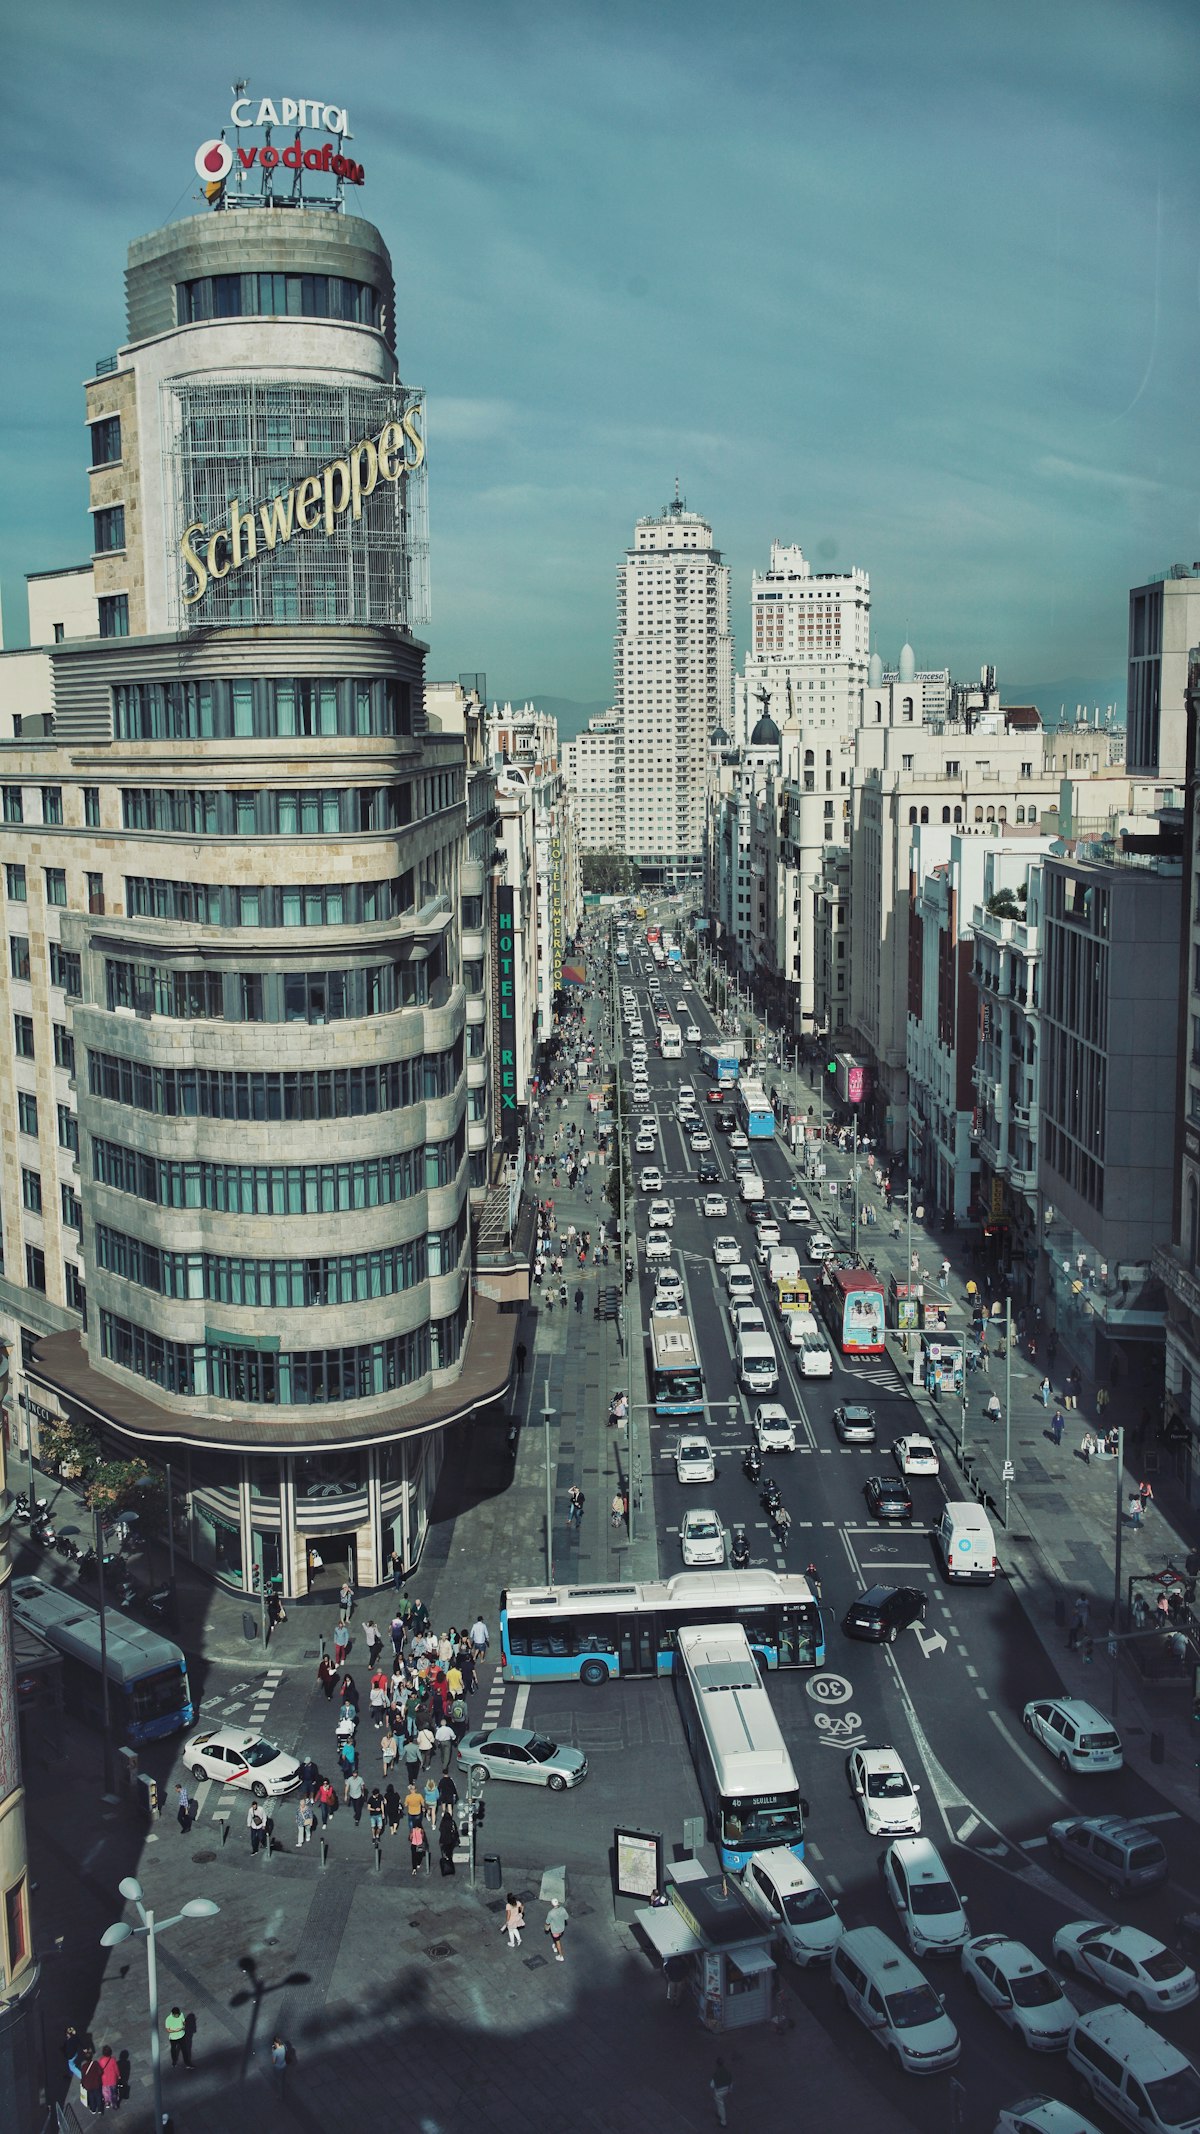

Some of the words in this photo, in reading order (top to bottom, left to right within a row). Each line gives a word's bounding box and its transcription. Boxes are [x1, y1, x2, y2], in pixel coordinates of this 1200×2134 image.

[231, 98, 353, 139] CAPITOL
[237, 139, 364, 185] vodafone
[181, 405, 424, 605] Schweppes
[552, 839, 560, 891] HOTEL
[500, 913, 513, 1018] HOTEL
[553, 898, 563, 991] EMPERADOR
[501, 1050, 516, 1109] REX
[817, 1681, 842, 1696] 30
